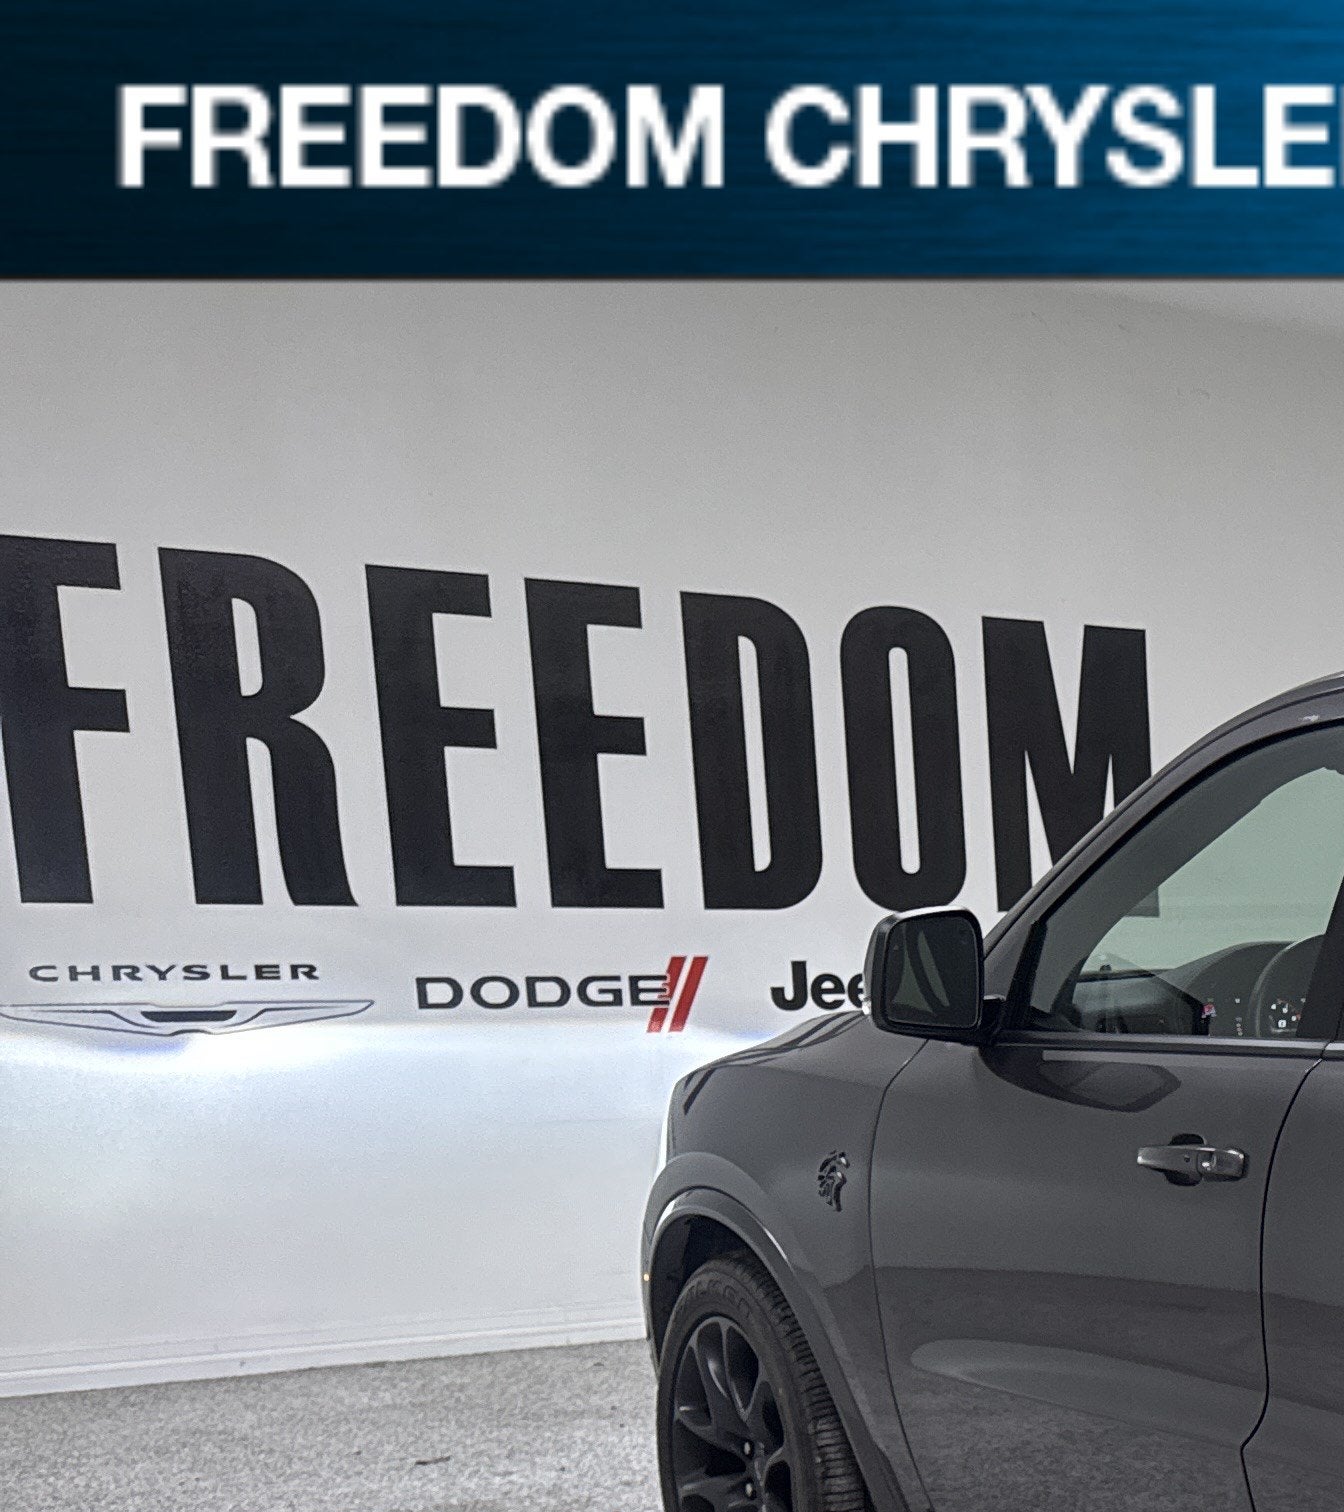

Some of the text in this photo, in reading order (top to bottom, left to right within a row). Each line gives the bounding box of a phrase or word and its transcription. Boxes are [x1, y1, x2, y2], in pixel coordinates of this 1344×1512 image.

[0, 534, 1160, 916] FREEDOM
[28, 963, 321, 984] CHRYSLER
[416, 974, 673, 1012] DODGE
